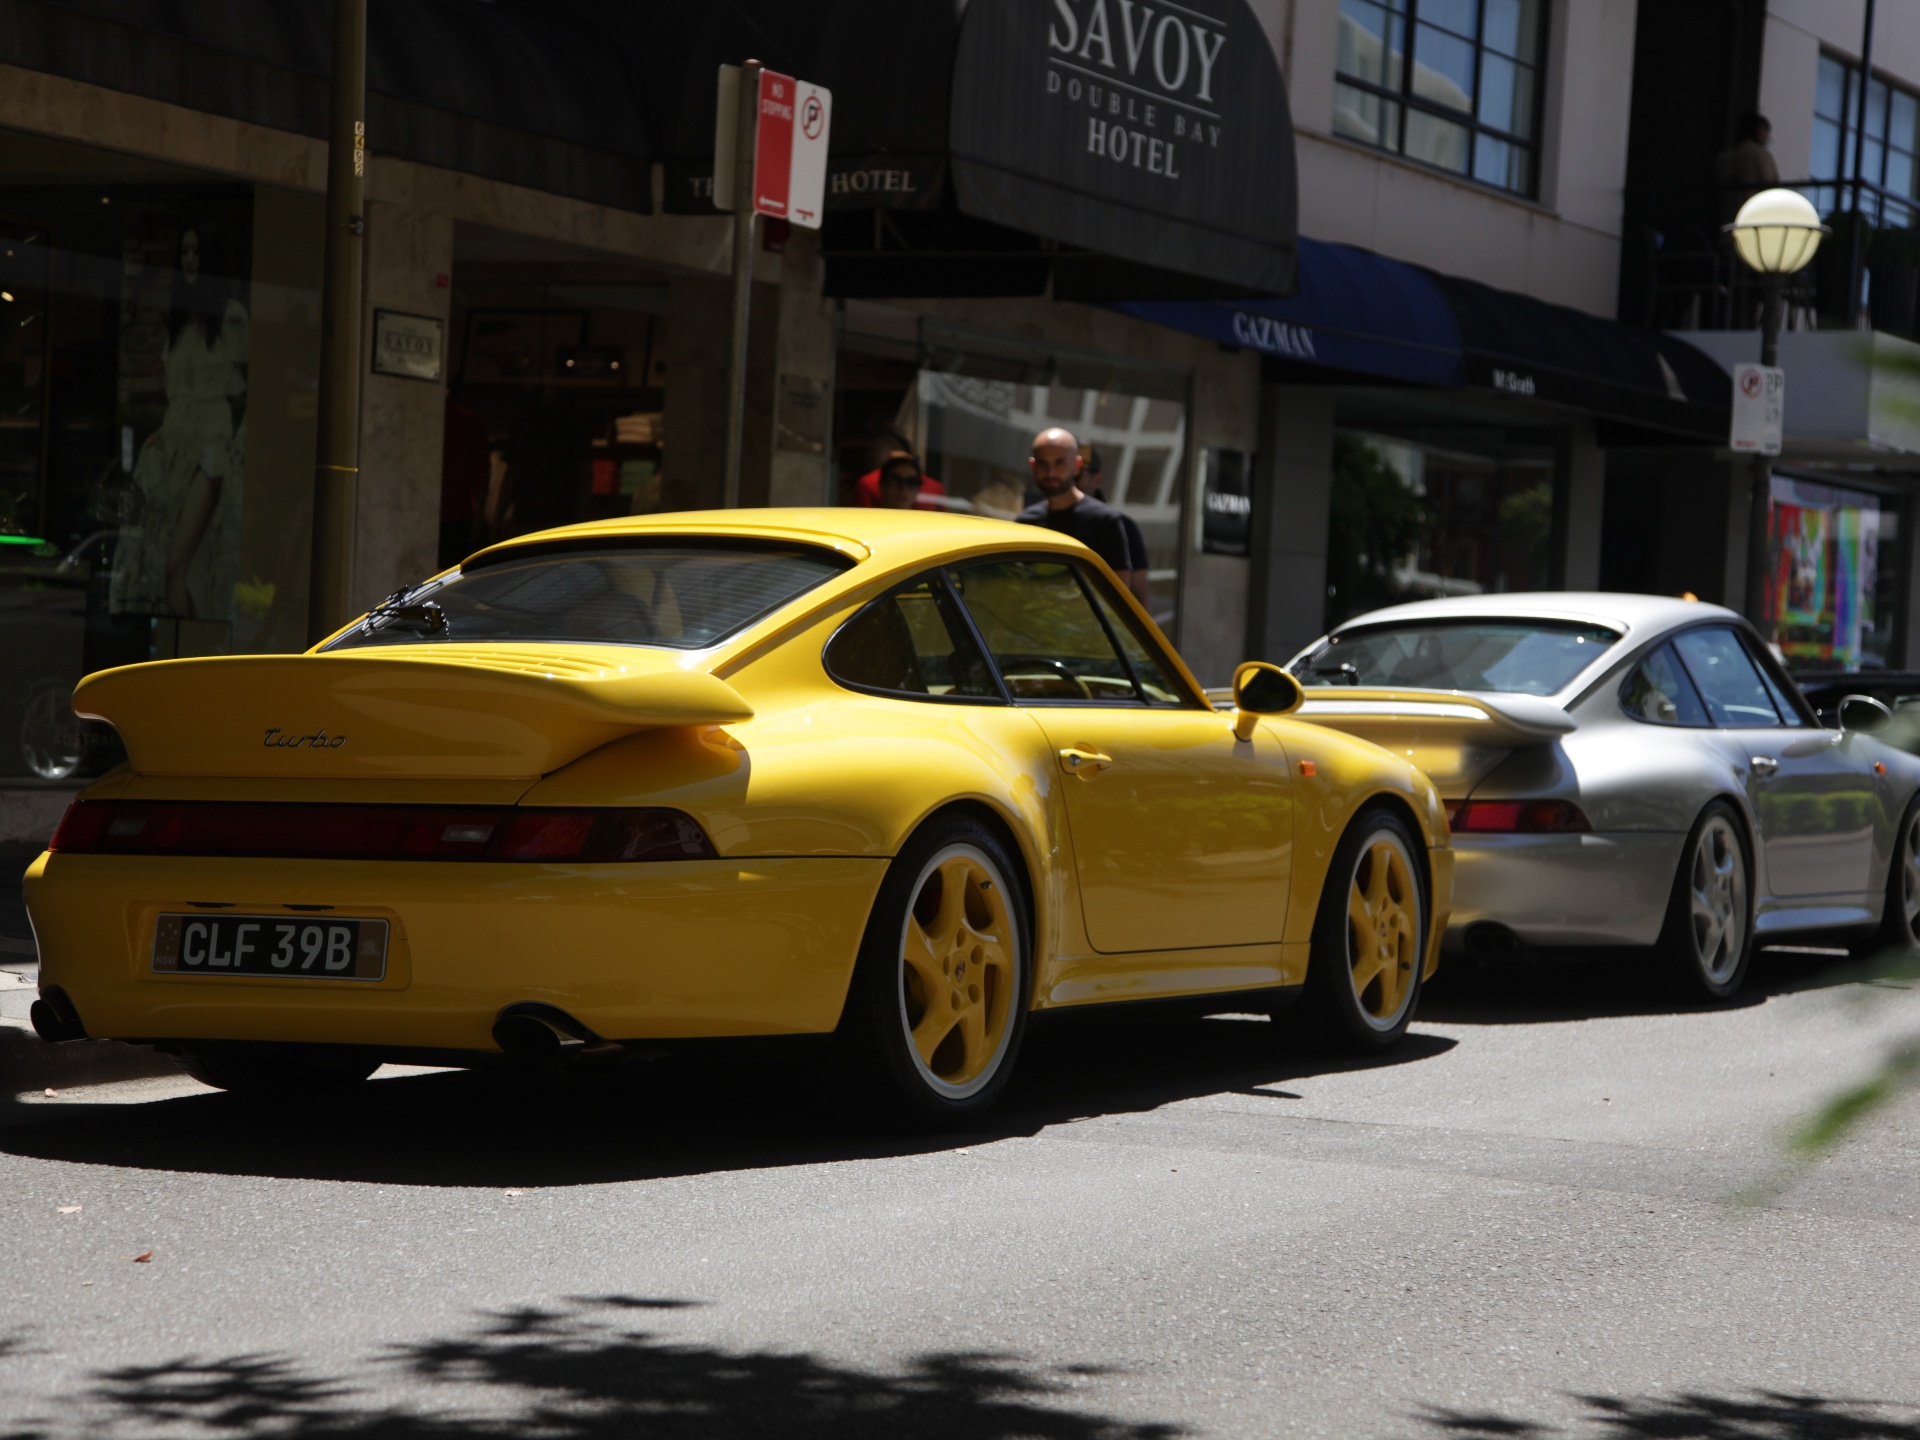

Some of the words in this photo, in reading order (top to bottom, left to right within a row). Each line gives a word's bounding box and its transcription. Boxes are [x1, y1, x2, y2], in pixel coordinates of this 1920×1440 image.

[1048, 0, 1226, 104] SAVOY
[761, 98, 793, 121] STOPPING
[771, 82, 785, 99] NO
[1046, 70, 1157, 128] DOUBLE
[1173, 113, 1222, 148] BAY
[1087, 116, 1180, 180] HOTEL
[688, 176, 714, 198] TH
[830, 169, 917, 194] HOTEL
[1232, 311, 1317, 360] GAZMAN
[155, 955, 177, 966] NSW
[183, 922, 261, 967] CLF
[270, 924, 351, 970] 39B
